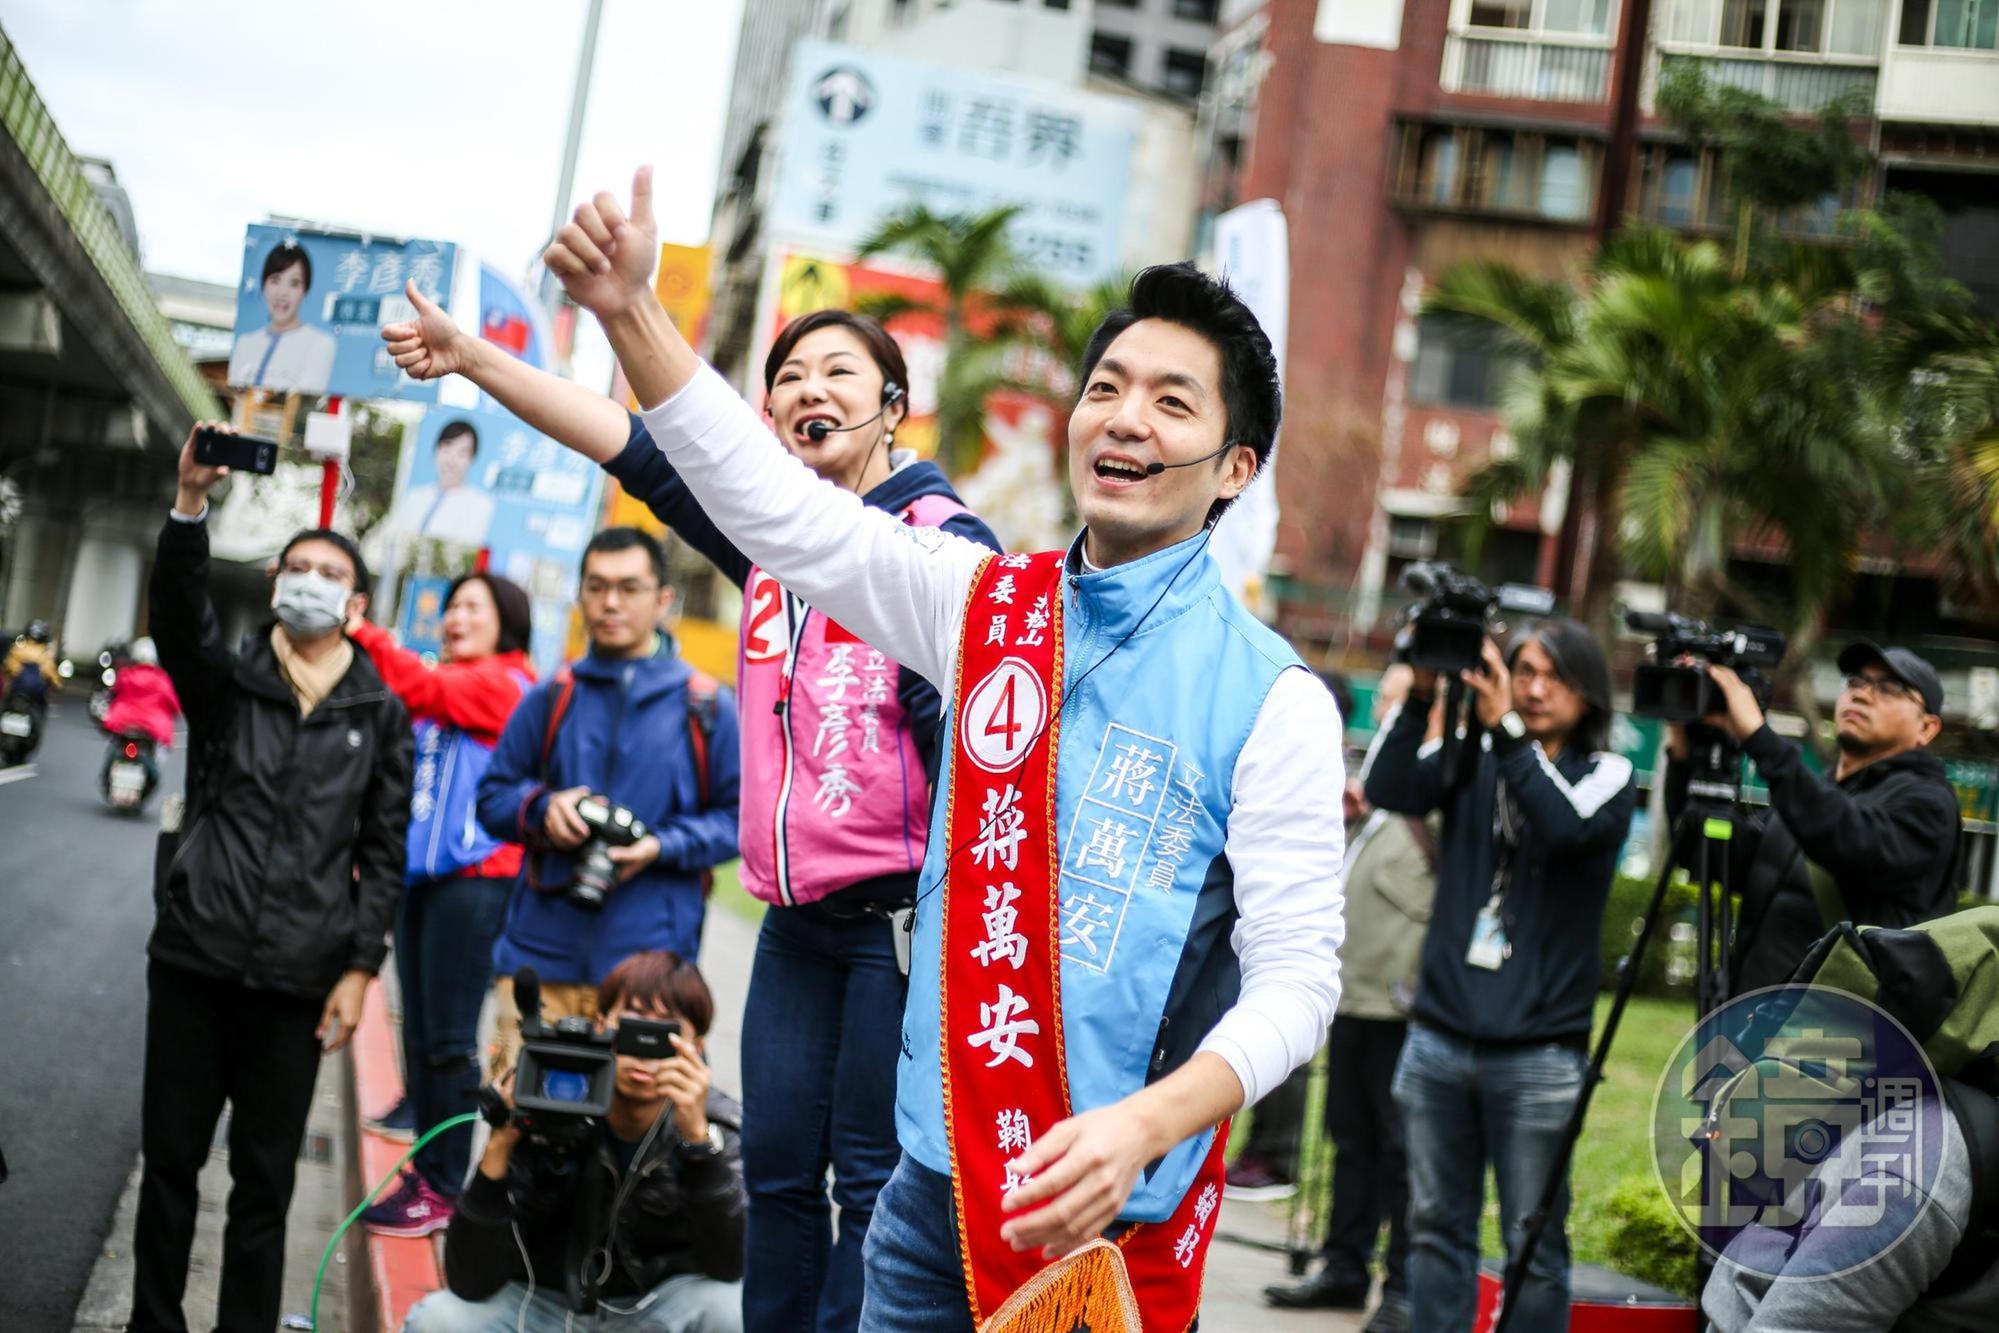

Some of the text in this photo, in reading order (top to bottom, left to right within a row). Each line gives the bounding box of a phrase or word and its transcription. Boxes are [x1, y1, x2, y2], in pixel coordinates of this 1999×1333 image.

[746, 578, 782, 654] 2
[861, 650, 888, 754] 立法委員
[1059, 743, 1164, 956] 蔣萬安
[1145, 760, 1206, 896] 立法委員
[967, 783, 1040, 1068] 蔣萬安
